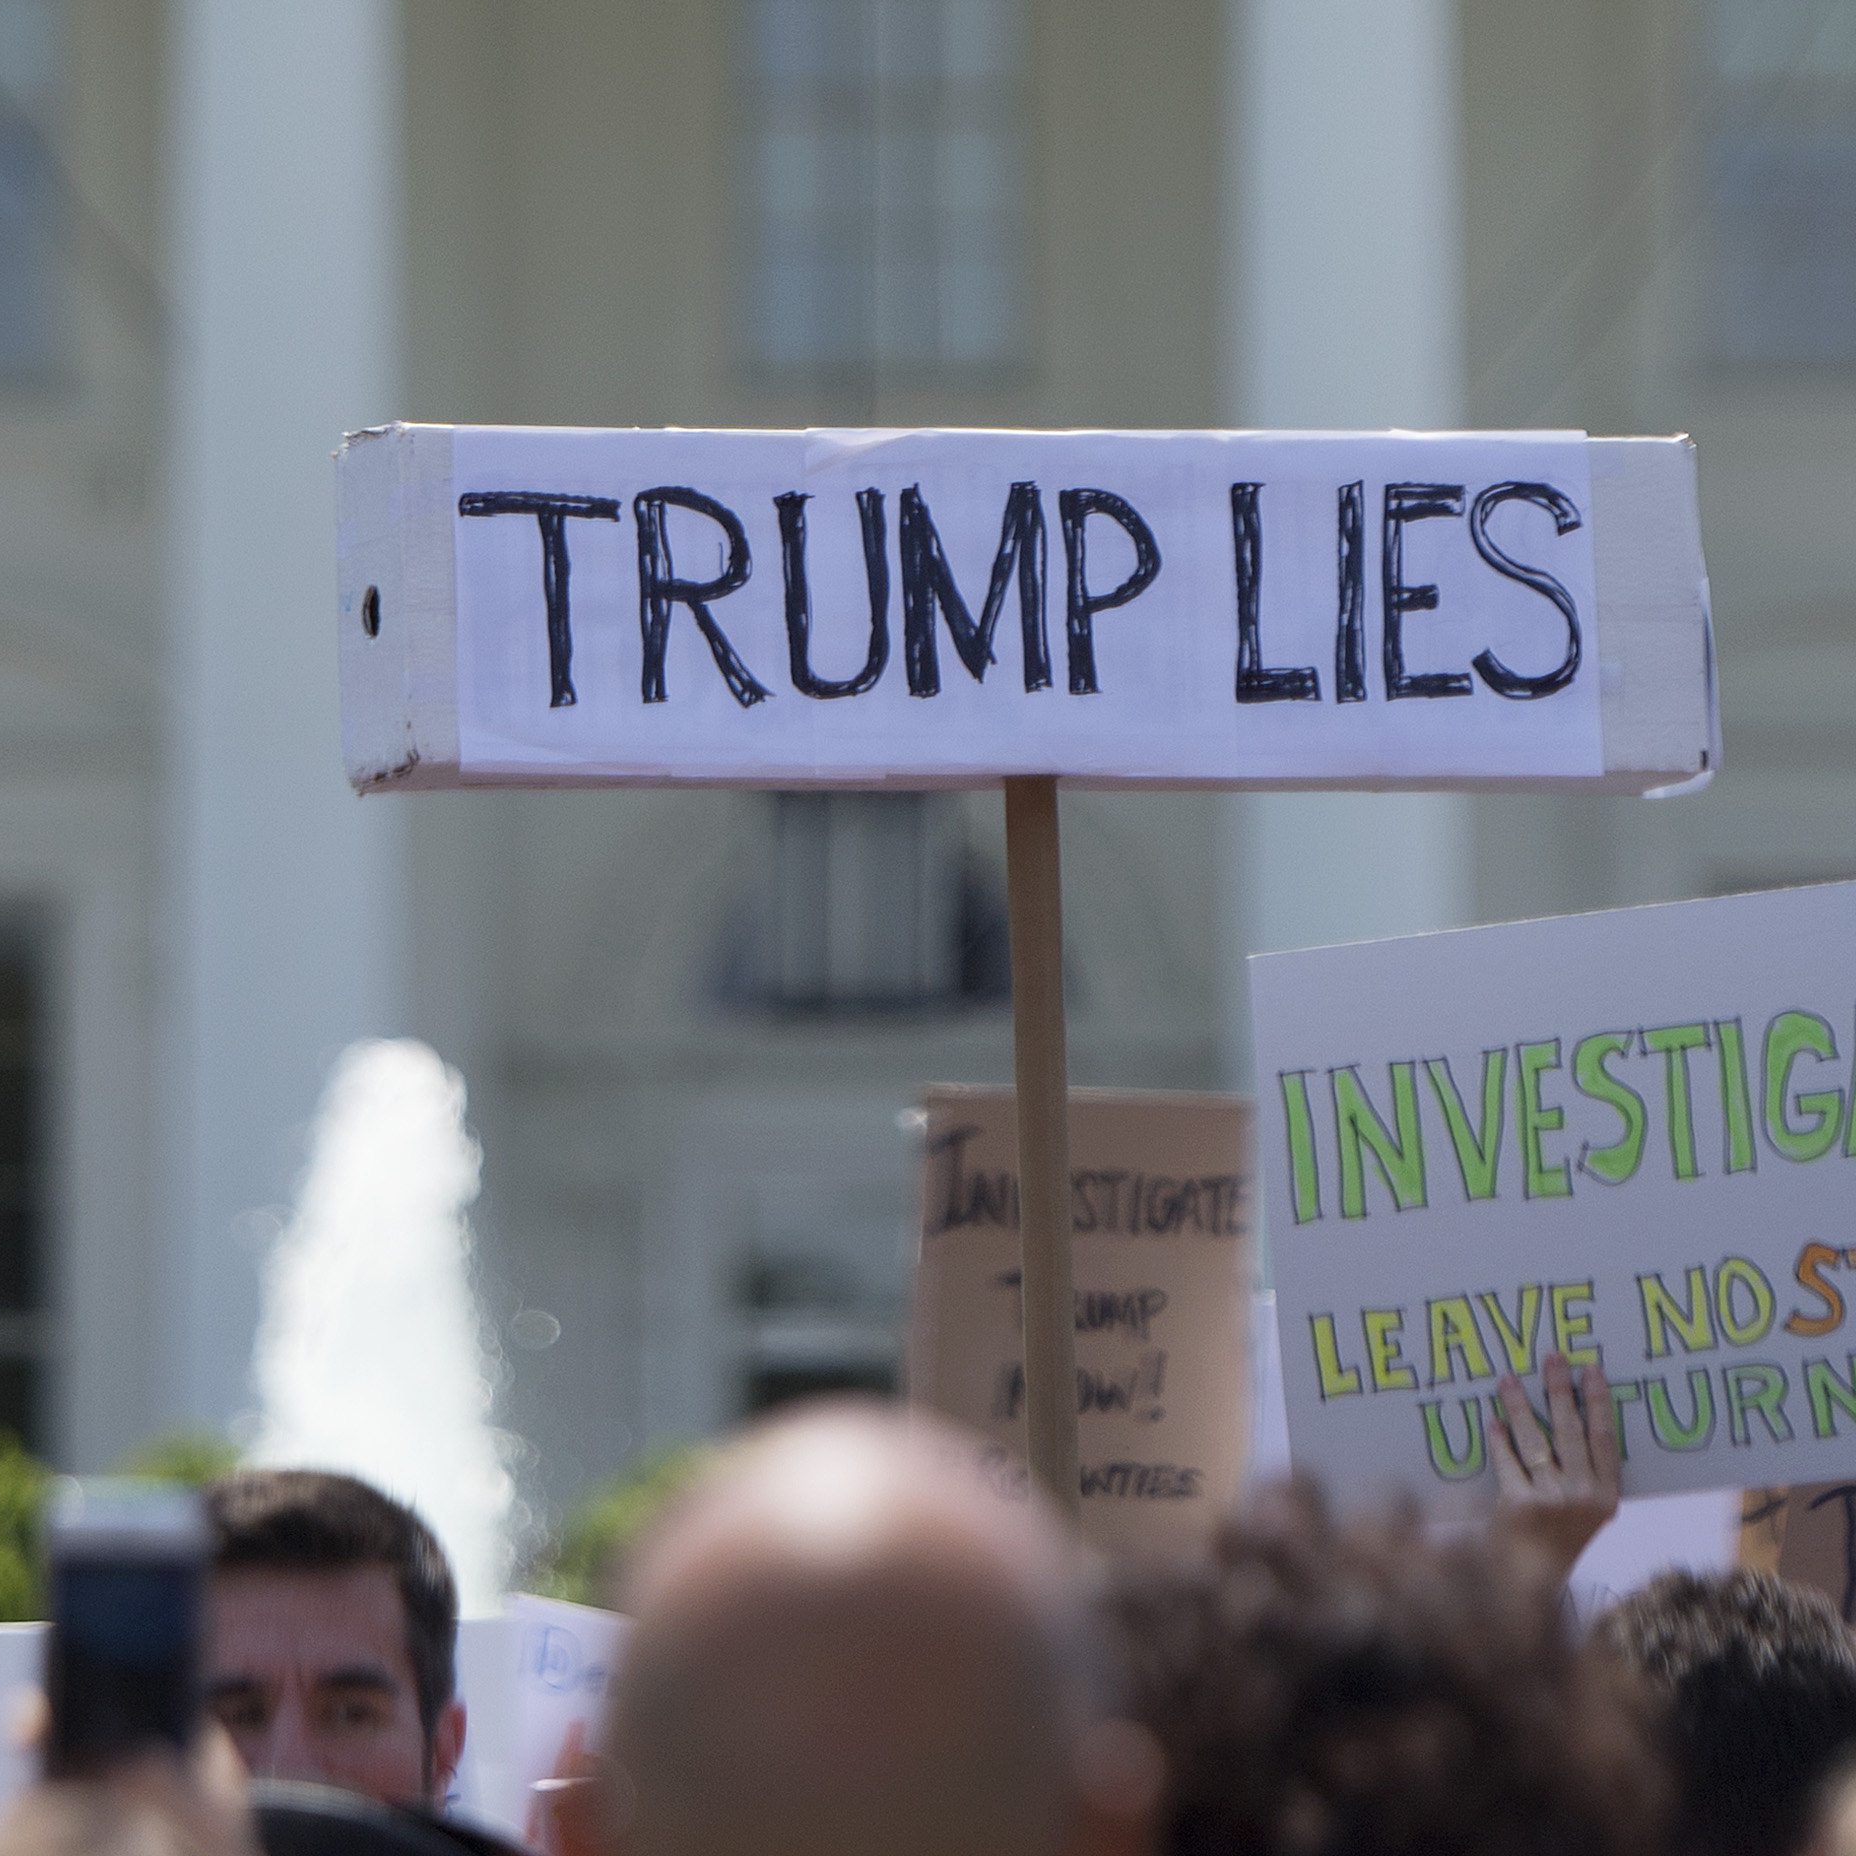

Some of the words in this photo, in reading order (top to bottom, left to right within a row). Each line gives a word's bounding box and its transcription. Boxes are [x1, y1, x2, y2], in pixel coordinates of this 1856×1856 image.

[458, 479, 1162, 708] TRUMP
[1231, 479, 1584, 705] LIES
[926, 1121, 1256, 1237] INSTIGATE
[1308, 1278, 1604, 1401] LEAVE
[1636, 1256, 1777, 1361] NO
